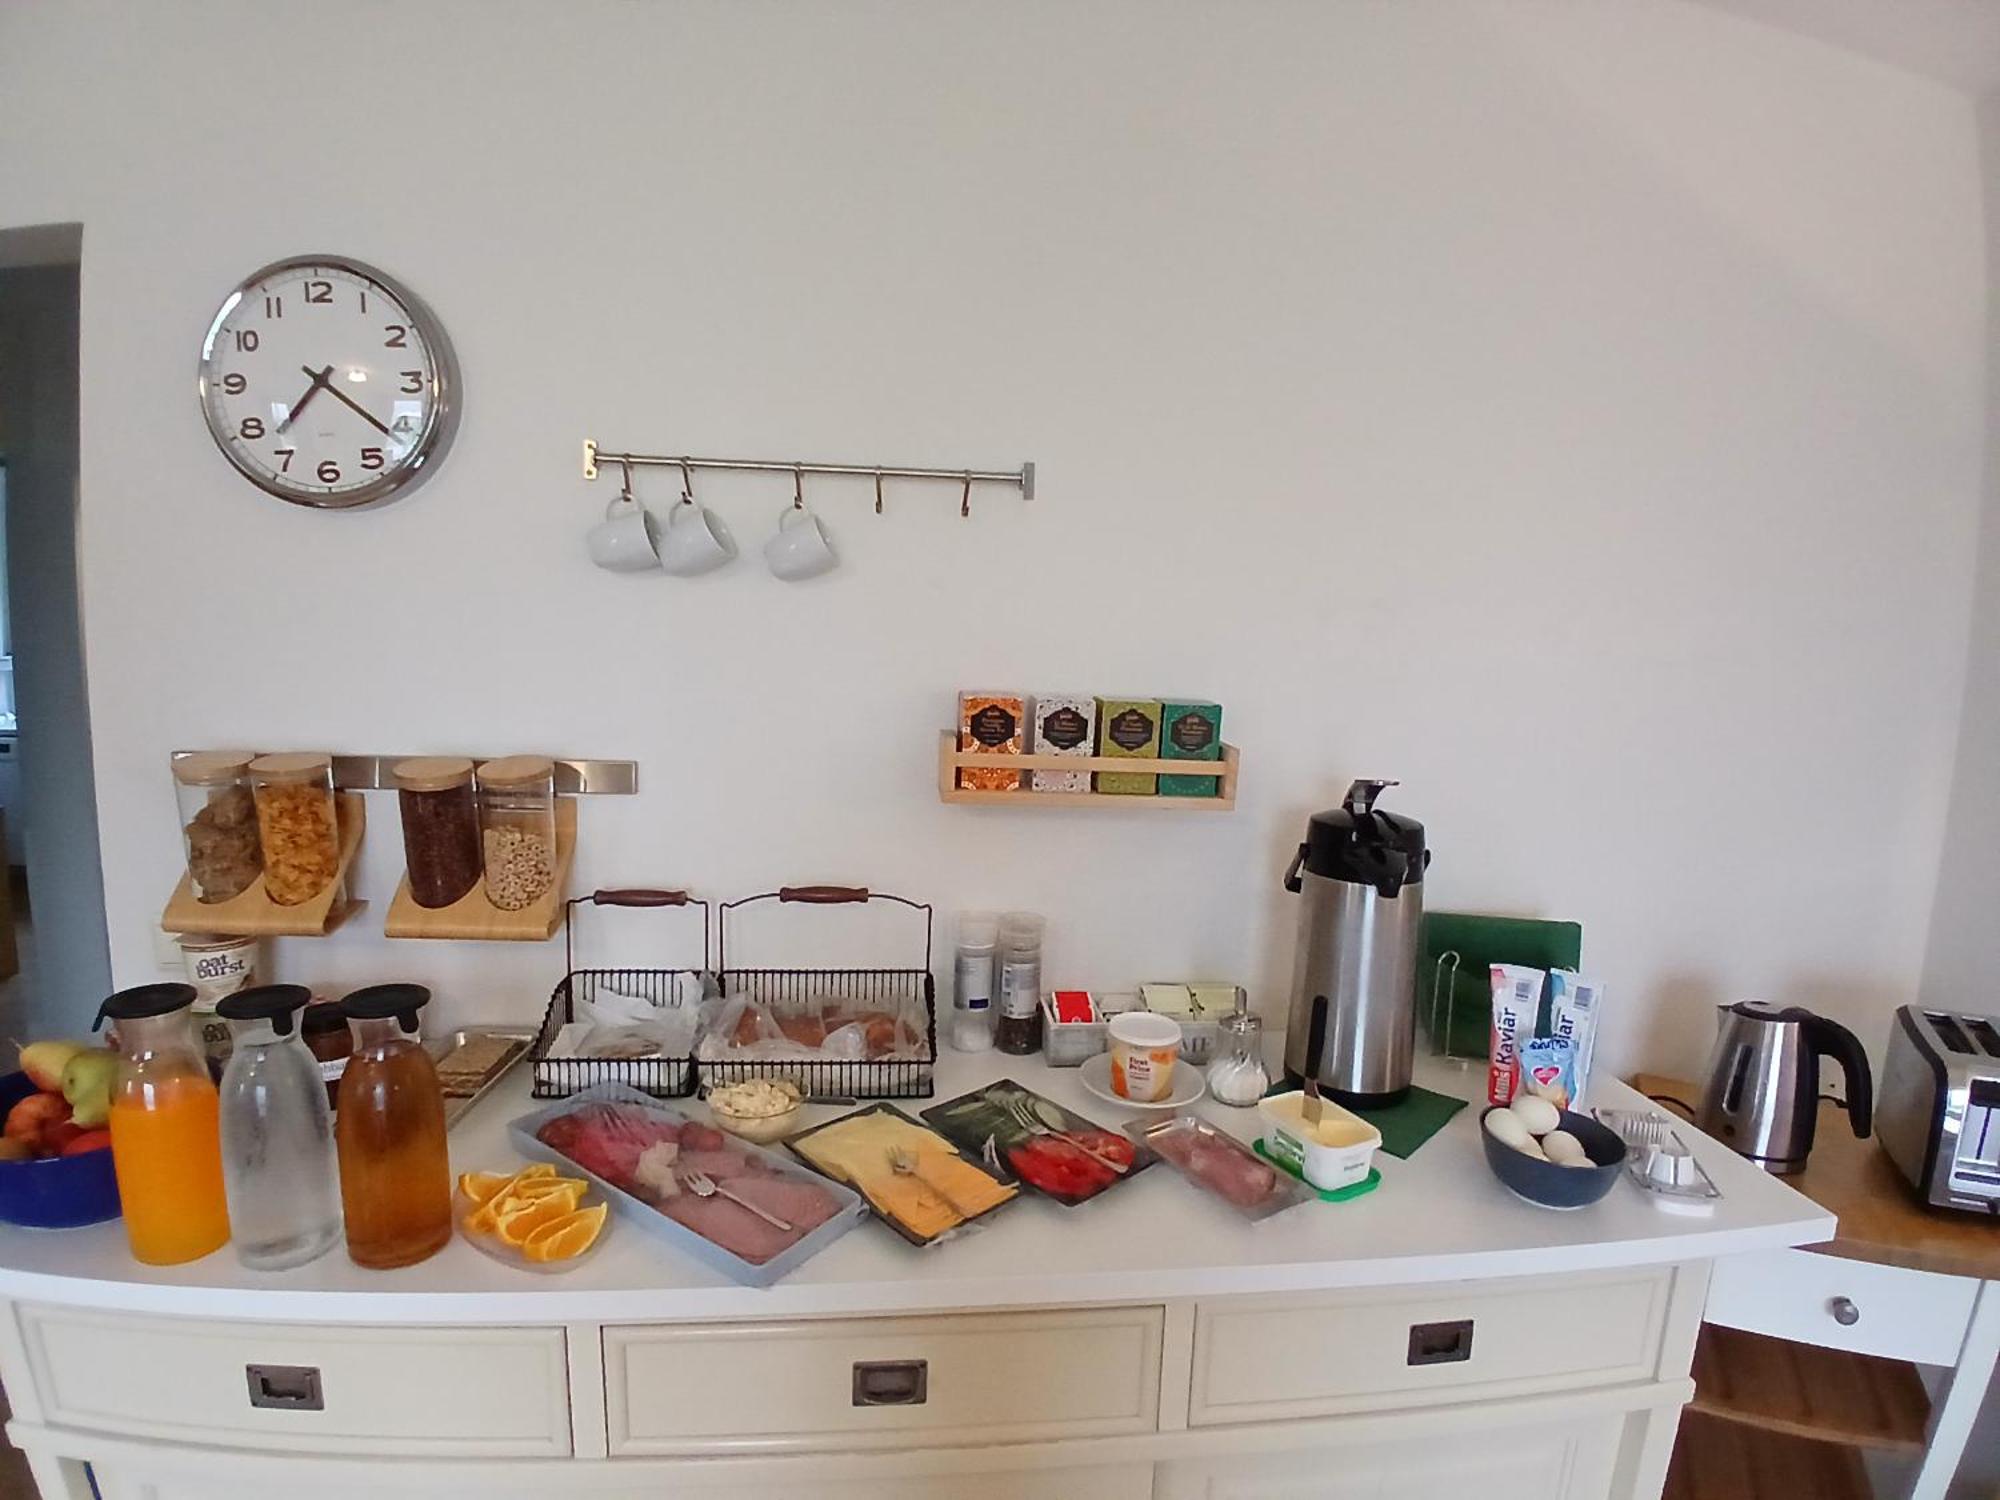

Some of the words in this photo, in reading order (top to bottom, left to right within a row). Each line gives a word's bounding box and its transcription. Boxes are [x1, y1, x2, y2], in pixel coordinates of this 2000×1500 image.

[304, 281, 333, 304] 12
[359, 292, 366, 313] 1
[265, 296, 282, 318] 11
[236, 330, 259, 352] 10
[384, 325, 407, 348] 2
[223, 373, 247, 395] 9
[400, 370, 423, 394] 3
[240, 417, 265, 440] 8
[393, 416, 414, 433] 4
[274, 449, 294, 472] 7
[360, 447, 385, 470] 5
[317, 460, 341, 484] 6
[196, 958, 245, 979] burst
[198, 953, 229, 968] oat
[1495, 1007, 1516, 1065] Kaviar
[1129, 1056, 1149, 1066] First
[1129, 1064, 1151, 1073] Price
